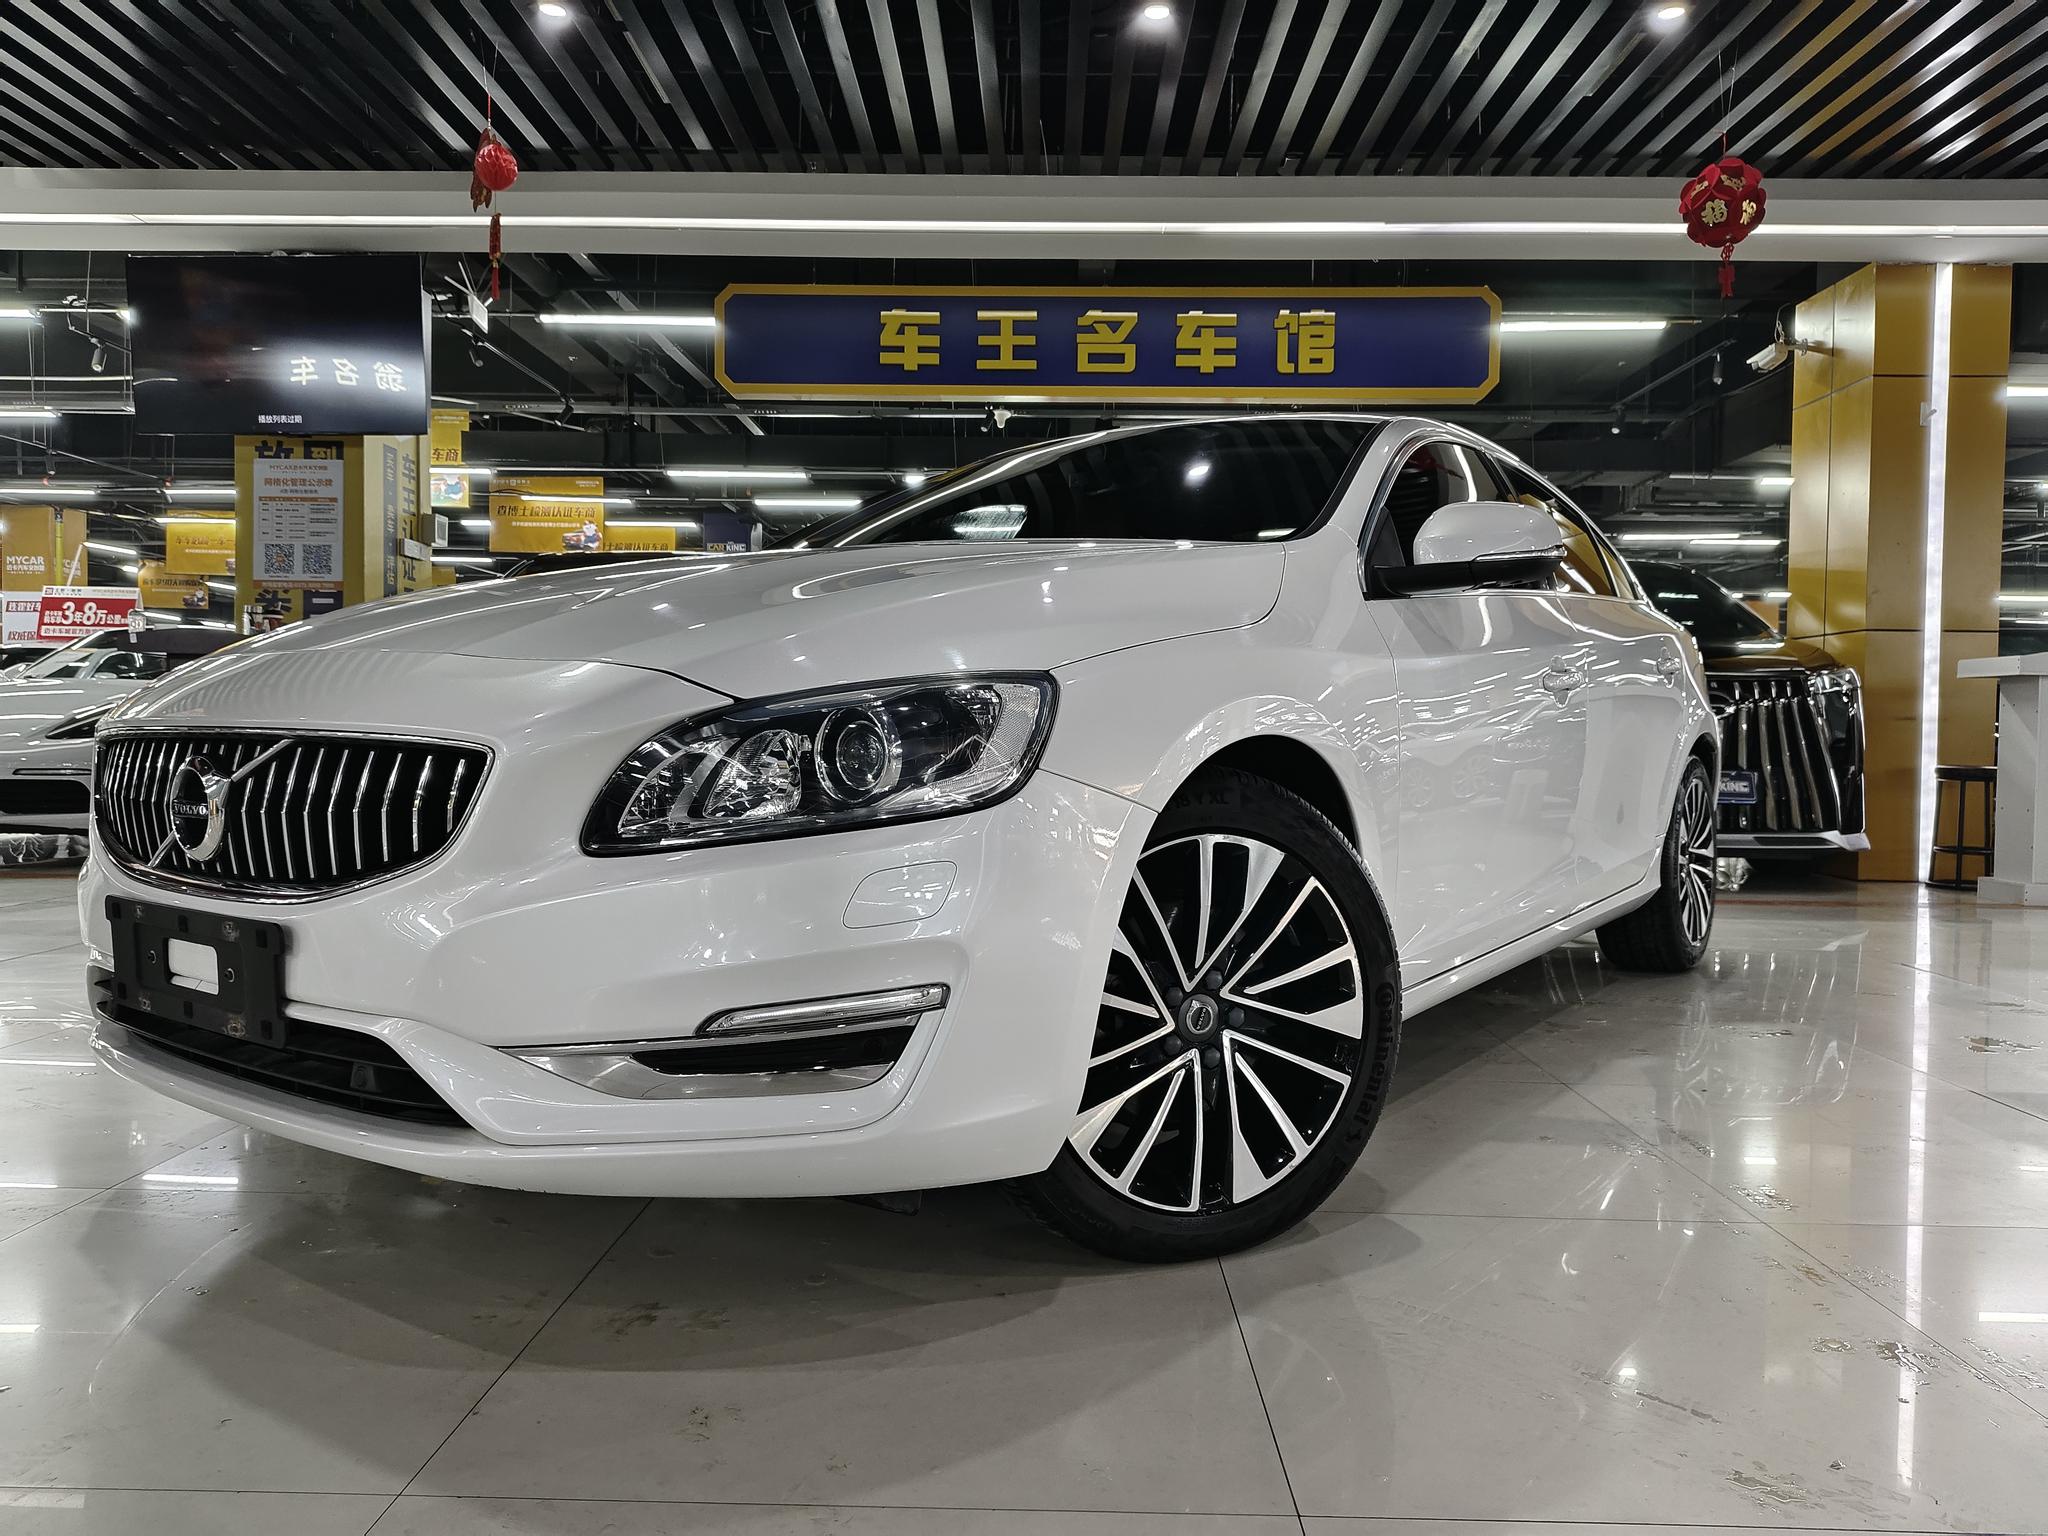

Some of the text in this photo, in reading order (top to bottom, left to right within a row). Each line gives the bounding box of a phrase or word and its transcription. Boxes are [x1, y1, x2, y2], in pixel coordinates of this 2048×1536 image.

[879, 309, 1336, 374] 车王名车馆
[258, 415, 302, 424] 播放列表过期
[6, 555, 45, 565] MYCAR
[174, 803, 207, 815] VOLVO
